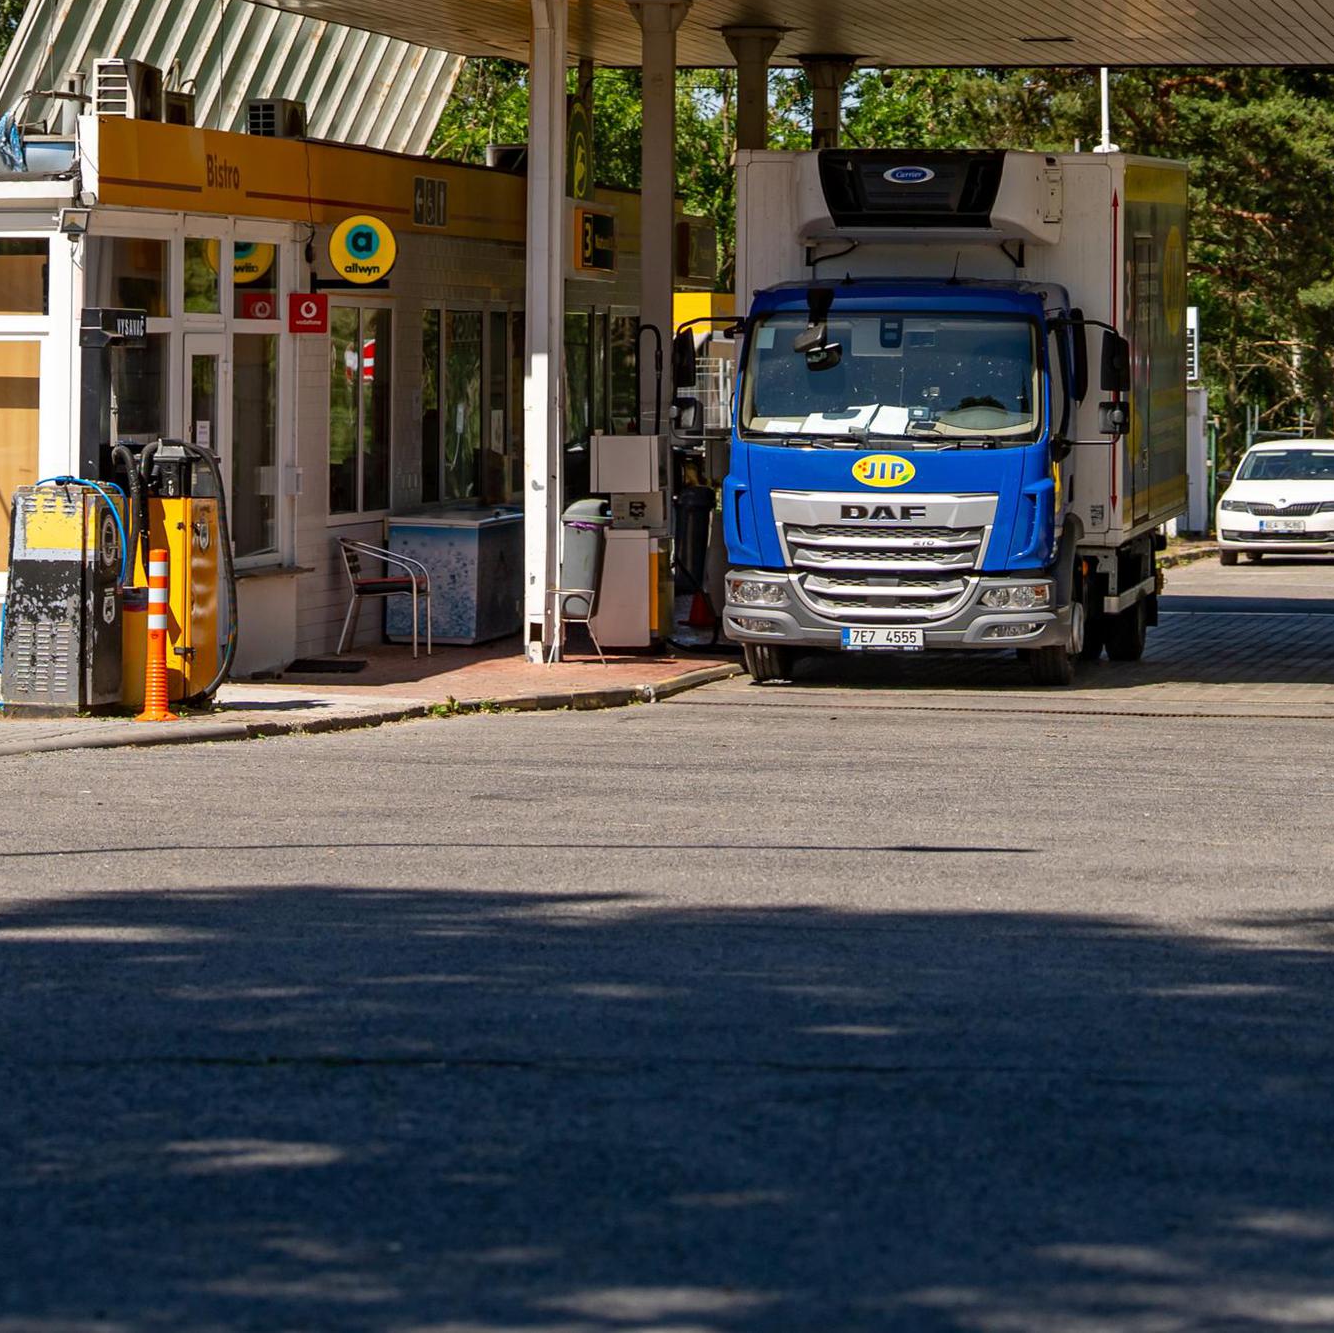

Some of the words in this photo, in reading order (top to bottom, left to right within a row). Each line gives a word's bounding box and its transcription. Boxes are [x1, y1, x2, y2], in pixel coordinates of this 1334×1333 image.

[207, 154, 240, 190] Bistro
[344, 263, 380, 276] allwyn
[863, 462, 905, 479] JIP
[840, 505, 926, 520] DAF
[853, 630, 876, 643] 7E7
[885, 631, 917, 643] 4555
